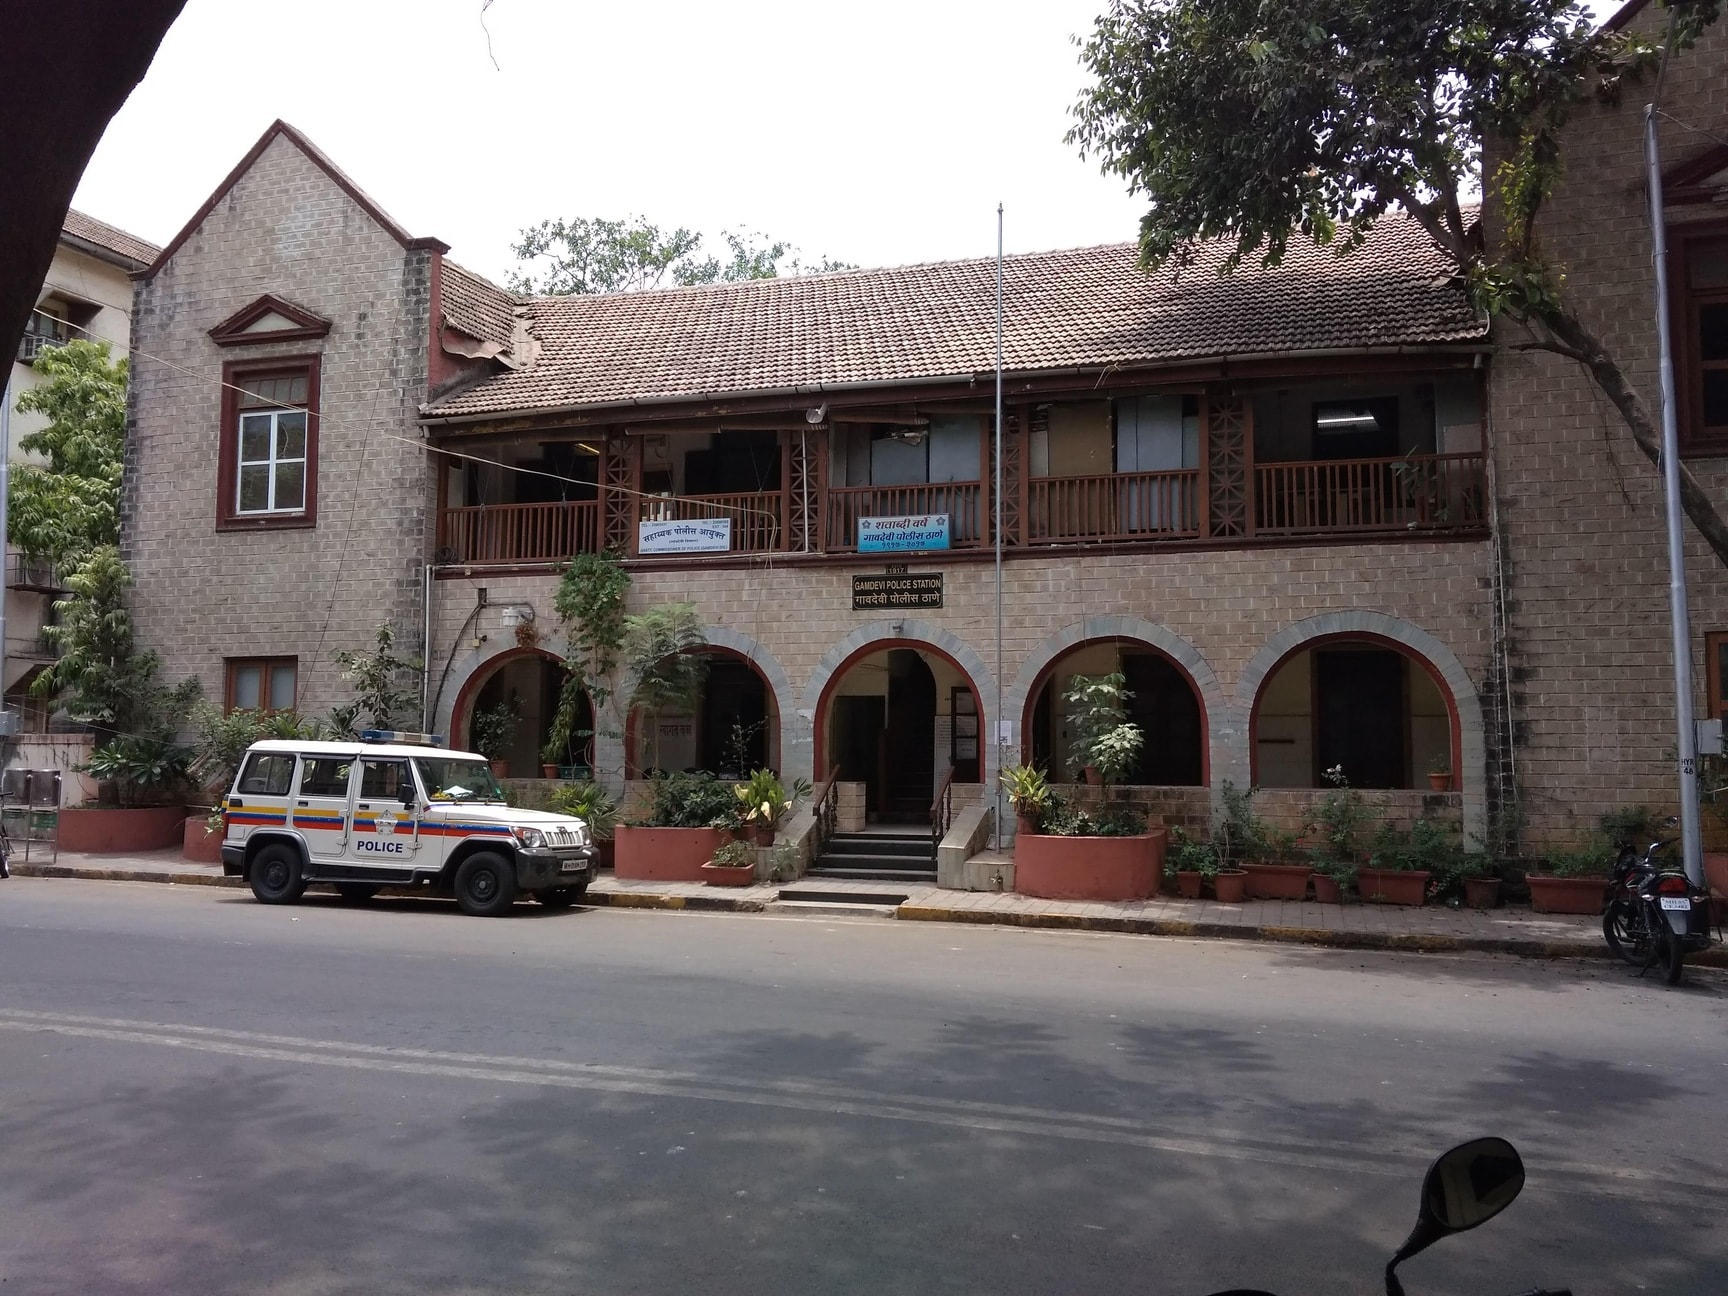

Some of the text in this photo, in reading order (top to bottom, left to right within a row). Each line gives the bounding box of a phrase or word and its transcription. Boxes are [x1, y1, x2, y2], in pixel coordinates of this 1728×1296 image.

[875, 518, 911, 530] शताब्दी
[674, 525, 698, 535] पोलीस
[699, 528, 726, 540] आयुक्त
[864, 530, 944, 542] गावदेवी पोलीस ठाणे
[854, 579, 940, 590] GAMDEVI POLICE STATION
[854, 590, 940, 604] गावदेवी पोलीस ठाणे
[357, 840, 404, 853] POLICE
